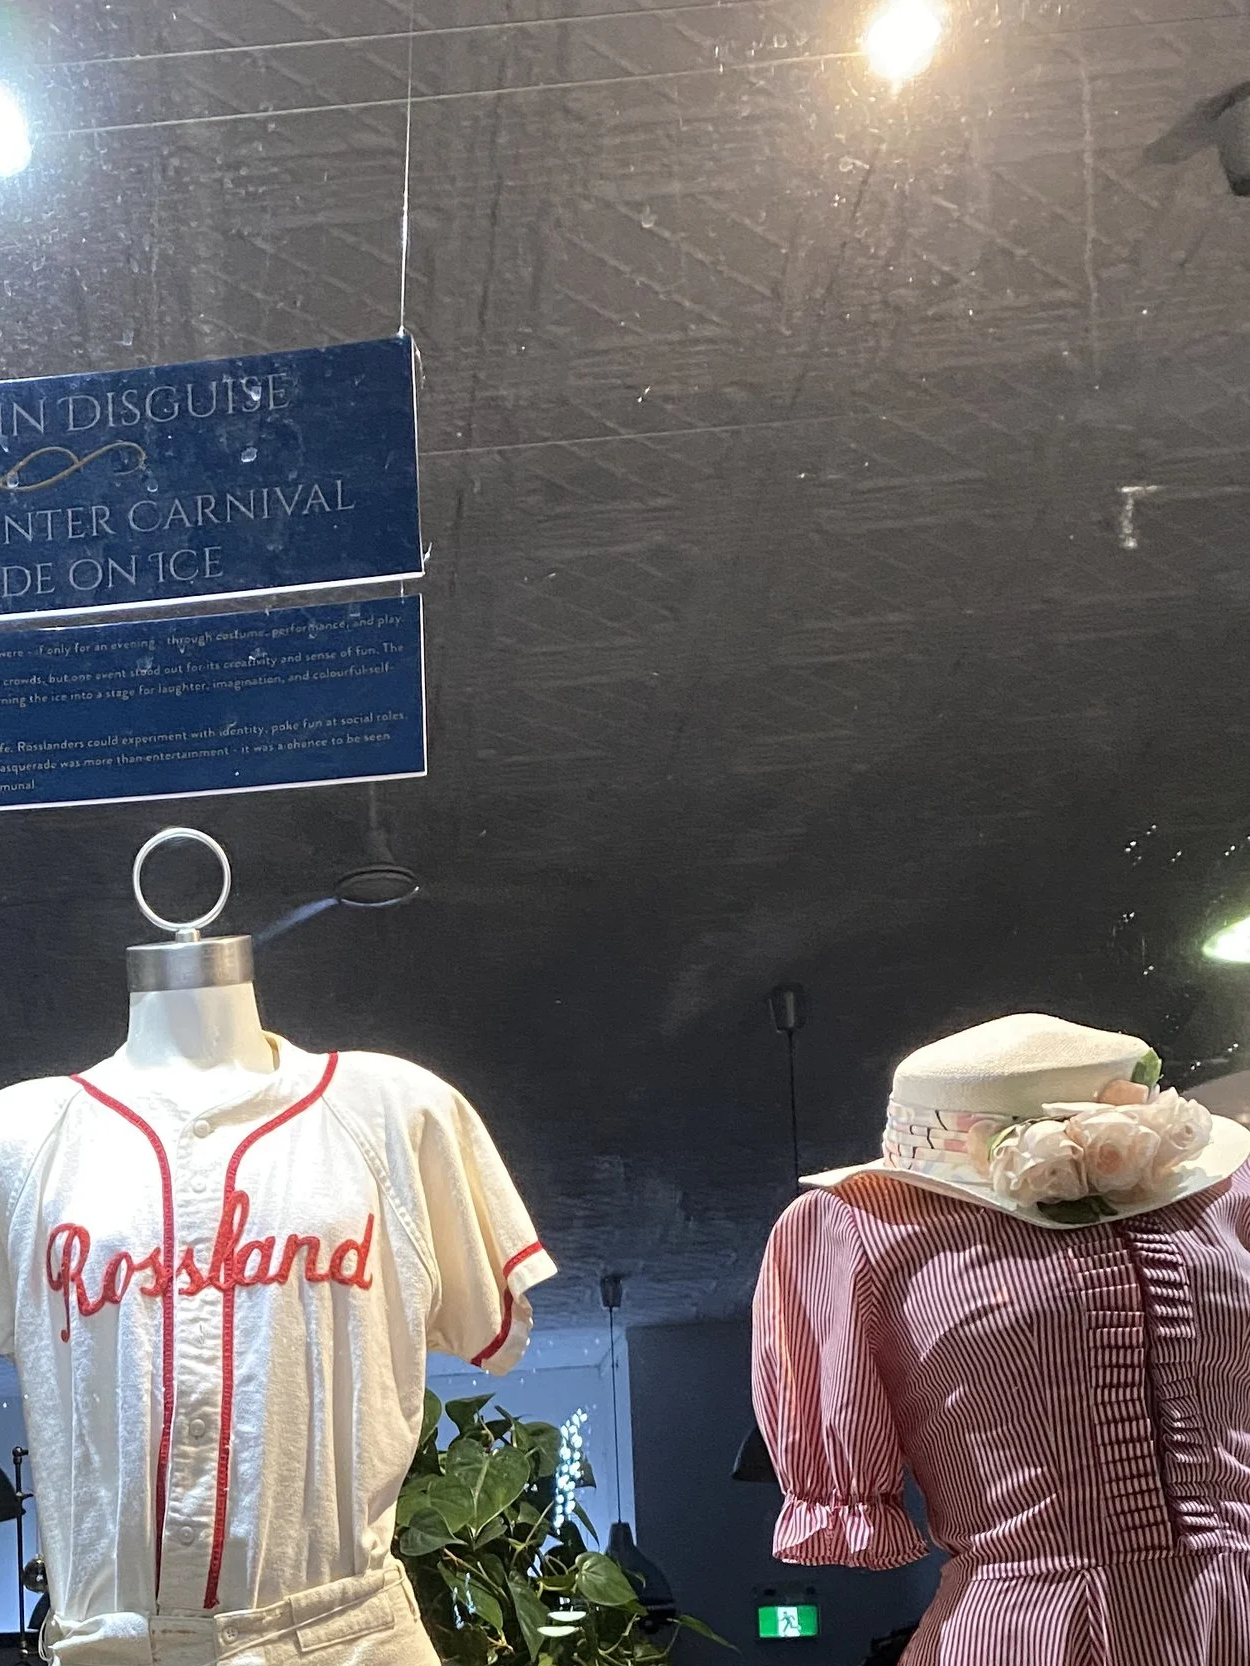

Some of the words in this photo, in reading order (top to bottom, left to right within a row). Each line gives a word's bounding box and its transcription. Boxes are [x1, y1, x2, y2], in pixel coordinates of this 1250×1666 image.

[58, 373, 288, 431] DISGUISE
[128, 479, 354, 533] CARNIVAL
[69, 552, 138, 589] ON
[148, 546, 223, 583] ICE
[47, 1190, 375, 1343] Rossland
